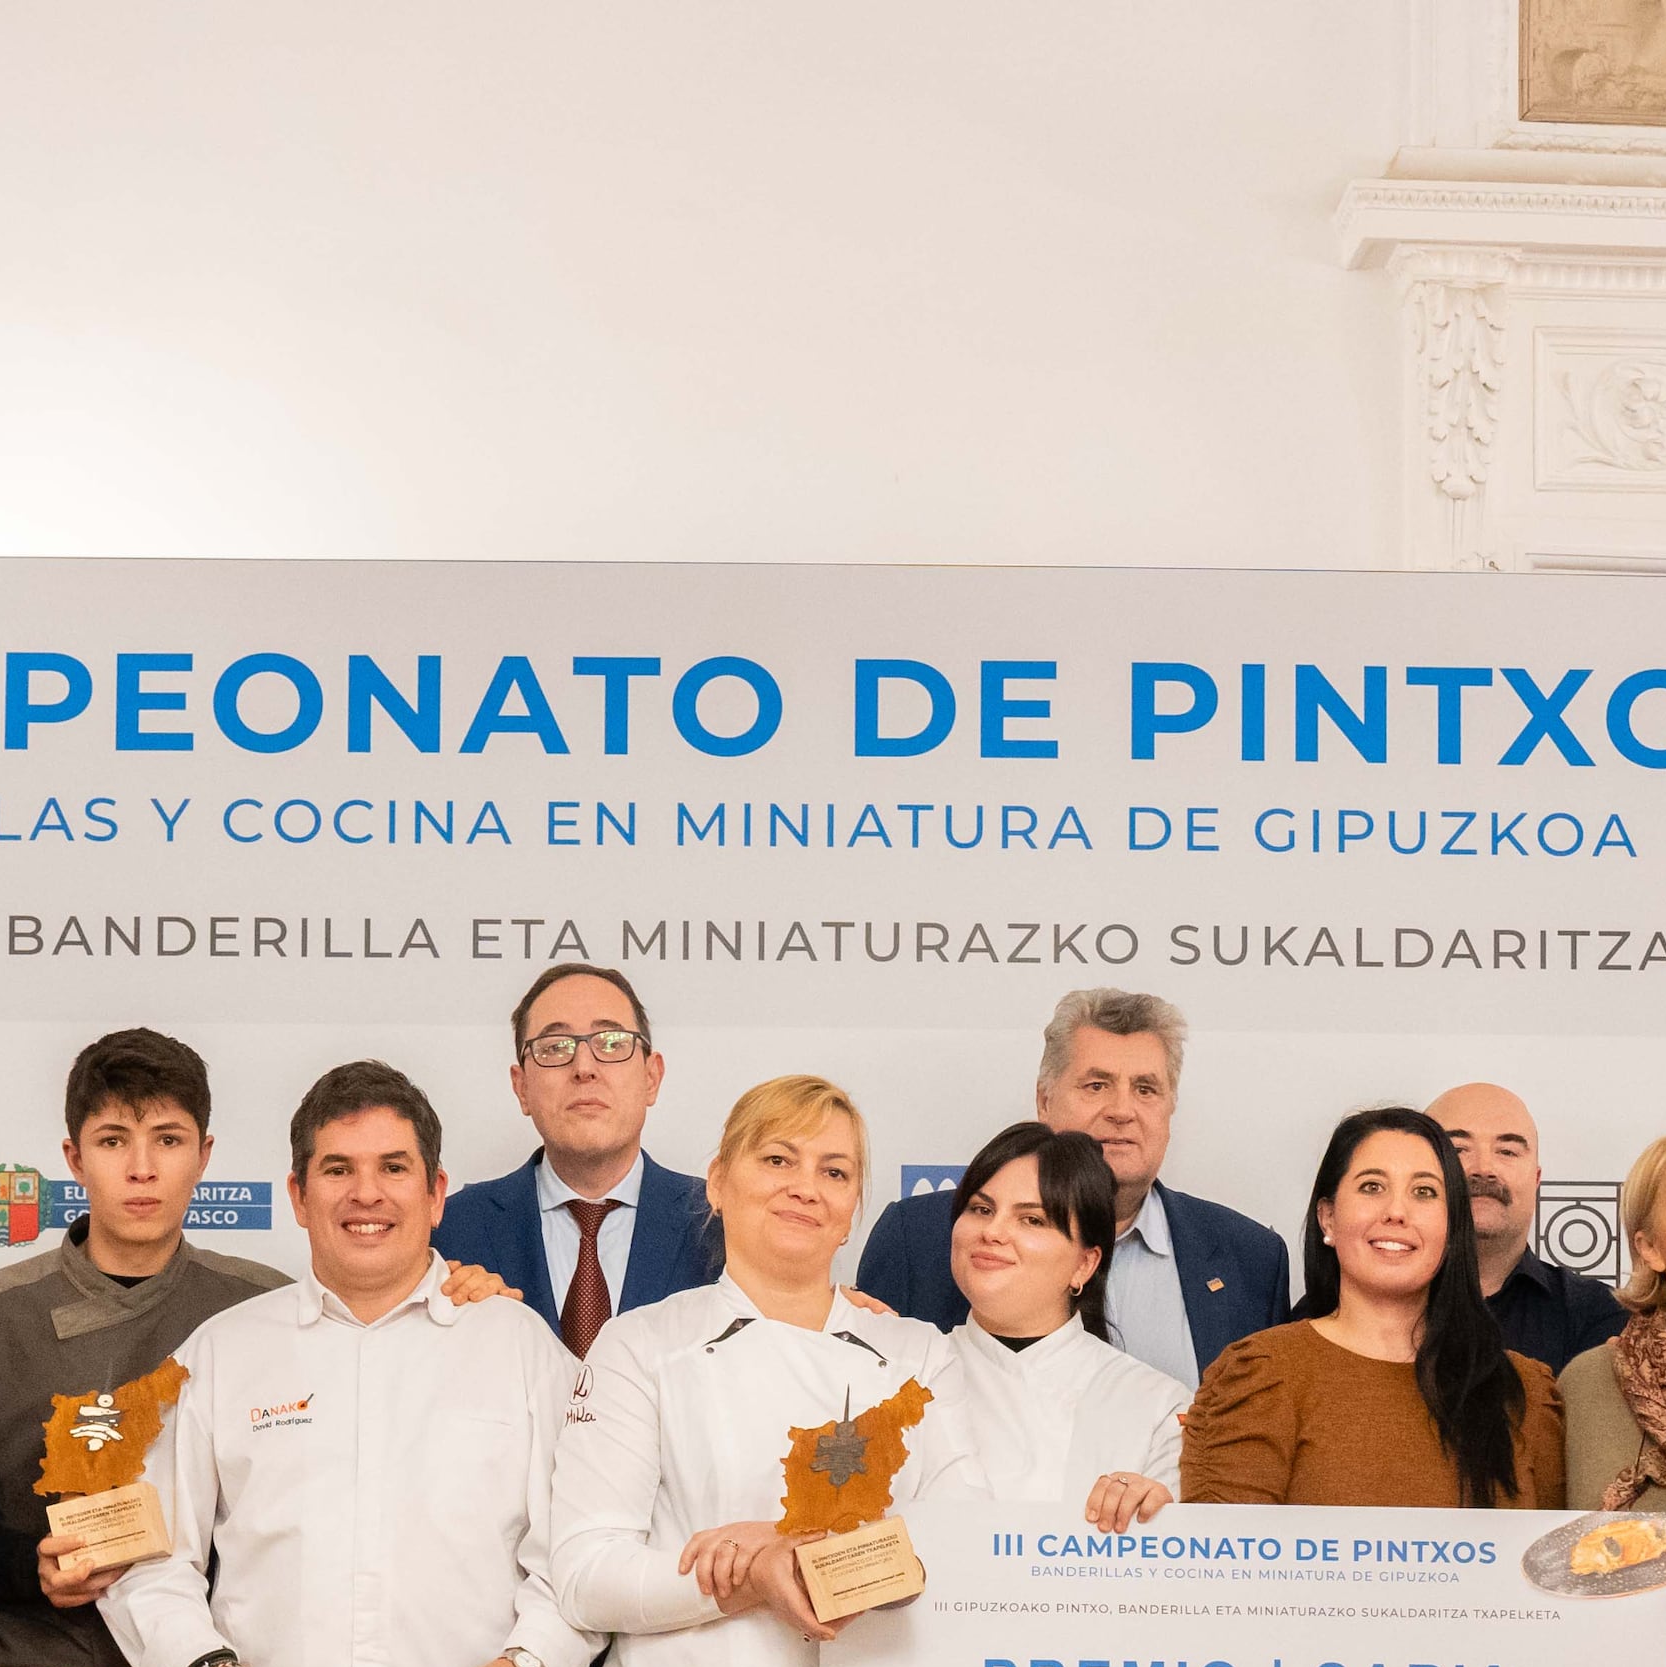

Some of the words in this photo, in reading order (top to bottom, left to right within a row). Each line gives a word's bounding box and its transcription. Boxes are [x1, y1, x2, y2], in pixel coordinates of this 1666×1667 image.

[854, 659, 1058, 759] DE
[150, 798, 190, 842] Y
[223, 798, 511, 844] COCINA
[548, 801, 635, 845] EN
[677, 803, 1093, 849] MINIATURA
[1129, 807, 1219, 851] DE
[1255, 808, 1637, 857] GIPUZKOA
[9, 915, 440, 958] BANDERILLA
[472, 918, 590, 959] ETA
[622, 919, 1138, 964] MINIATURAZKO
[253, 1421, 272, 1432] David
[275, 1417, 313, 1427] Rodríguez
[993, 1533, 1022, 1556] III
[1037, 1533, 1281, 1560] CAMPEONATO
[1296, 1538, 1339, 1561] DE
[1353, 1540, 1496, 1564] PINTXOS
[1031, 1565, 1142, 1578] BANDERILLAS
[1148, 1568, 1157, 1577] Y
[1164, 1568, 1225, 1579] COCINA
[1231, 1569, 1251, 1579] EN
[1258, 1569, 1346, 1581] MINIATURA
[1352, 1570, 1372, 1581] DE
[1379, 1571, 1459, 1582] GIPUZKOA
[934, 1601, 947, 1611] III
[953, 1601, 1050, 1612] GIPUZKOAKO
[1056, 1603, 1112, 1614] PINTXO,
[1118, 1604, 1210, 1615] BANDERILLA
[1216, 1605, 1241, 1615] ETA
[1247, 1606, 1355, 1617] MINIATURAZKO
[1361, 1607, 1468, 1618] SUKALDARITZA
[1473, 1609, 1560, 1620] TXAPELKETA
